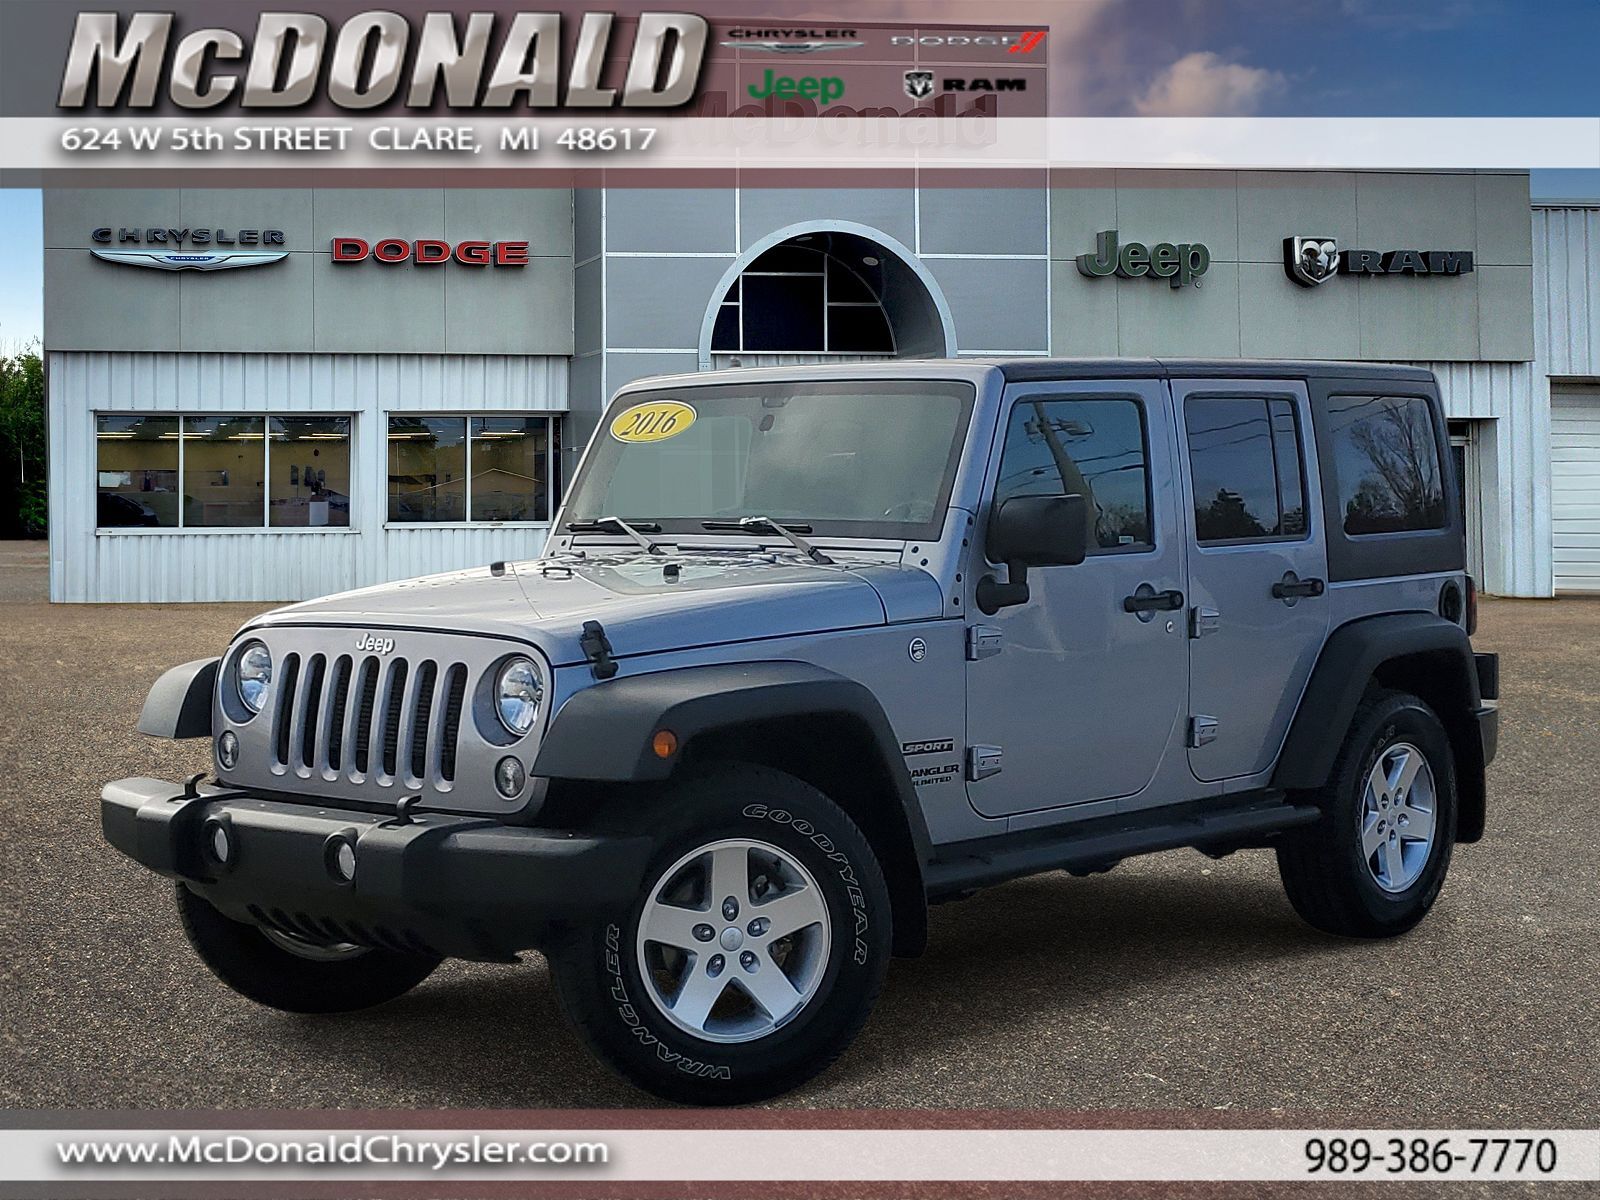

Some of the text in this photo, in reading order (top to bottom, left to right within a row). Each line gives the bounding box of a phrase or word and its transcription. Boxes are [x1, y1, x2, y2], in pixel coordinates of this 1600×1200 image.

[91, 227, 286, 245] CHRYSLER
[331, 237, 530, 268] DODGE
[1076, 230, 1211, 289] Jeep
[1338, 249, 1474, 275] RAM
[619, 409, 686, 437] 2016
[355, 632, 396, 656] Jeep
[904, 743, 952, 753] SPORT
[909, 764, 960, 777] ANGLER
[742, 803, 869, 966] GOODYEAR
[605, 923, 732, 1080] WRANGLER
